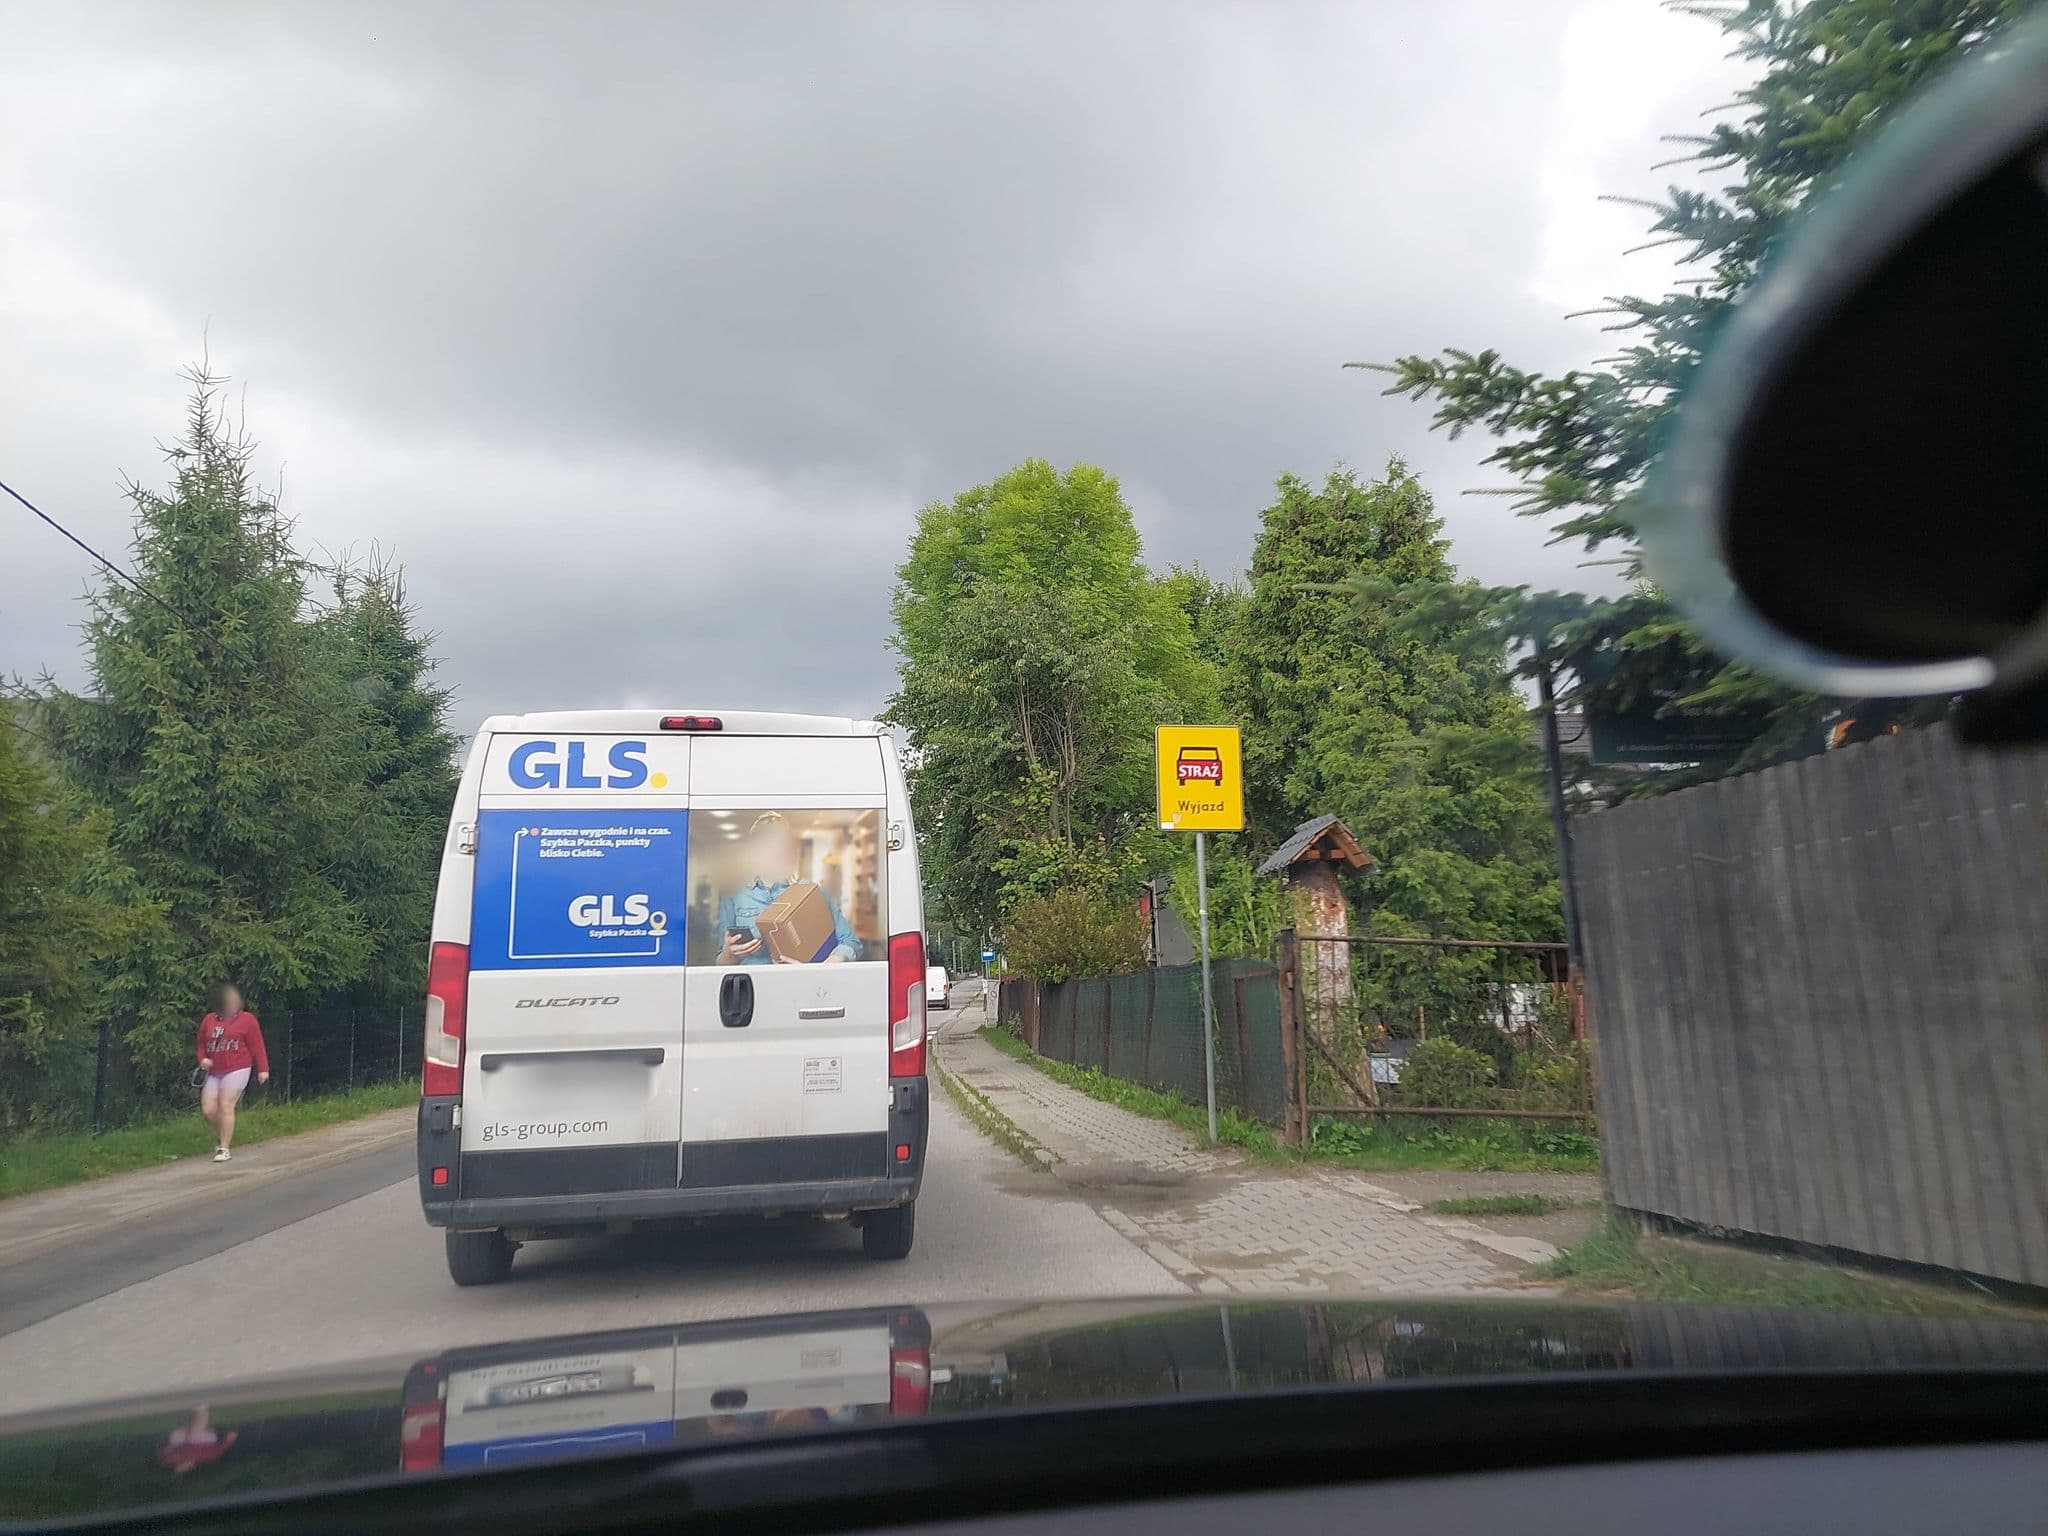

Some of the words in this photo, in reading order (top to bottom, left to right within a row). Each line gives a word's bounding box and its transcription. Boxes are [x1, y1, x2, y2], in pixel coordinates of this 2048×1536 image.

[1178, 763, 1219, 777] STRAŻ
[1178, 801, 1224, 814] Wyjazd
[541, 827, 578, 836] Zawsze
[580, 827, 628, 838] wygodnie
[648, 827, 671, 835] czas.
[540, 838, 576, 848] Szybka
[577, 838, 614, 847] Paczka,
[615, 838, 651, 848] punkty
[540, 848, 570, 857] blisko
[571, 849, 605, 857] Ciebie.
[589, 929, 617, 939] Szybka
[514, 996, 620, 1008] DUCATO
[482, 1120, 608, 1141] gls-group.com
